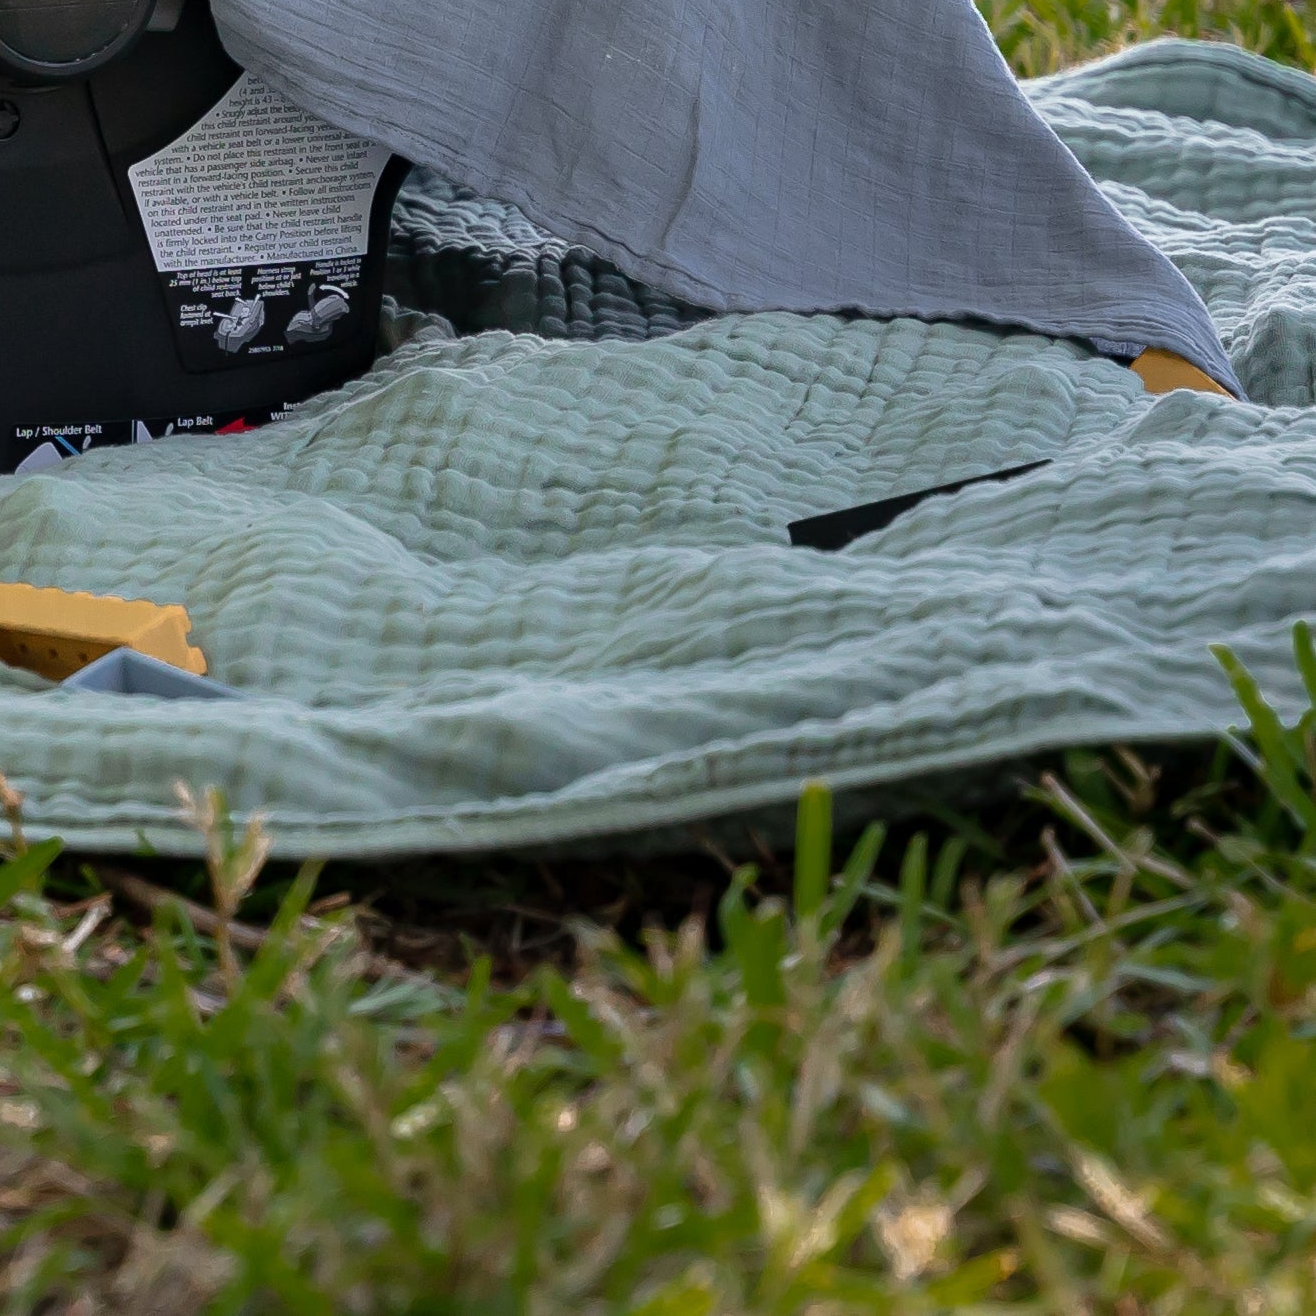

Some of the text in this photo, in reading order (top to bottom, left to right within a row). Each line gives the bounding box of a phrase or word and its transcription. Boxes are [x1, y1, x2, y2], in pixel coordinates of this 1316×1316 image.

[217, 120, 236, 129] child
[239, 118, 271, 127] restraint
[273, 115, 302, 124] around
[222, 109, 245, 118] Snugly
[247, 108, 268, 117] adjust
[270, 106, 282, 114] the
[171, 145, 189, 153] with
[199, 142, 226, 151] vehicle
[246, 139, 261, 147] belt
[307, 132, 342, 142] universal
[187, 133, 206, 141] child
[208, 131, 240, 140] restraint
[255, 125, 314, 136] forward-facing
[193, 154, 205, 162] Do
[207, 153, 221, 161] not
[223, 152, 244, 161] place
[263, 147, 296, 156] restraint
[325, 143, 343, 151] front
[362, 140, 369, 148] of
[135, 168, 163, 177] vehicle
[207, 163, 247, 173] passenger
[306, 155, 329, 163] Never
[138, 178, 171, 187] restraint
[190, 173, 248, 183] forward-facing
[324, 164, 338, 172] this
[340, 162, 358, 170] child
[141, 189, 174, 197] restraint
[177, 186, 195, 194] with
[197, 185, 210, 193] the
[213, 182, 246, 191] vehicle's
[248, 180, 268, 188] child
[271, 178, 303, 187] restraint
[306, 175, 347, 184] anchorage
[203, 194, 221, 202] with
[230, 191, 259, 200] vehicle
[289, 187, 315, 195] Follow
[318, 185, 327, 193] all
[329, 183, 371, 192] instructions
[151, 218, 181, 228] located
[183, 217, 208, 225] under
[210, 215, 223, 223] the
[322, 205, 341, 213] child
[161, 209, 175, 217] this
[178, 207, 198, 215] child
[200, 204, 233, 213] restraint
[236, 202, 251, 210] and
[264, 200, 277, 208] the
[279, 199, 309, 207] written
[311, 195, 355, 204] instructions
[265, 221, 278, 229] the
[281, 219, 301, 227] child
[303, 217, 335, 226] restraint
[337, 214, 362, 223] handle
[166, 239, 189, 248] firmly
[192, 236, 219, 245] locked
[280, 230, 311, 238] Position
[314, 227, 339, 235] before
[341, 225, 361, 233] lifting
[176, 248, 196, 257] child
[244, 243, 276, 252] Register
[279, 242, 297, 250] your
[299, 238, 319, 247] child
[321, 236, 351, 245] restraint
[163, 260, 182, 268] with
[185, 259, 198, 267] the
[267, 248, 323, 260] Manufactured
[16, 424, 102, 439] Lap / Shoulder Belt
[177, 416, 213, 428] Lap Belt
